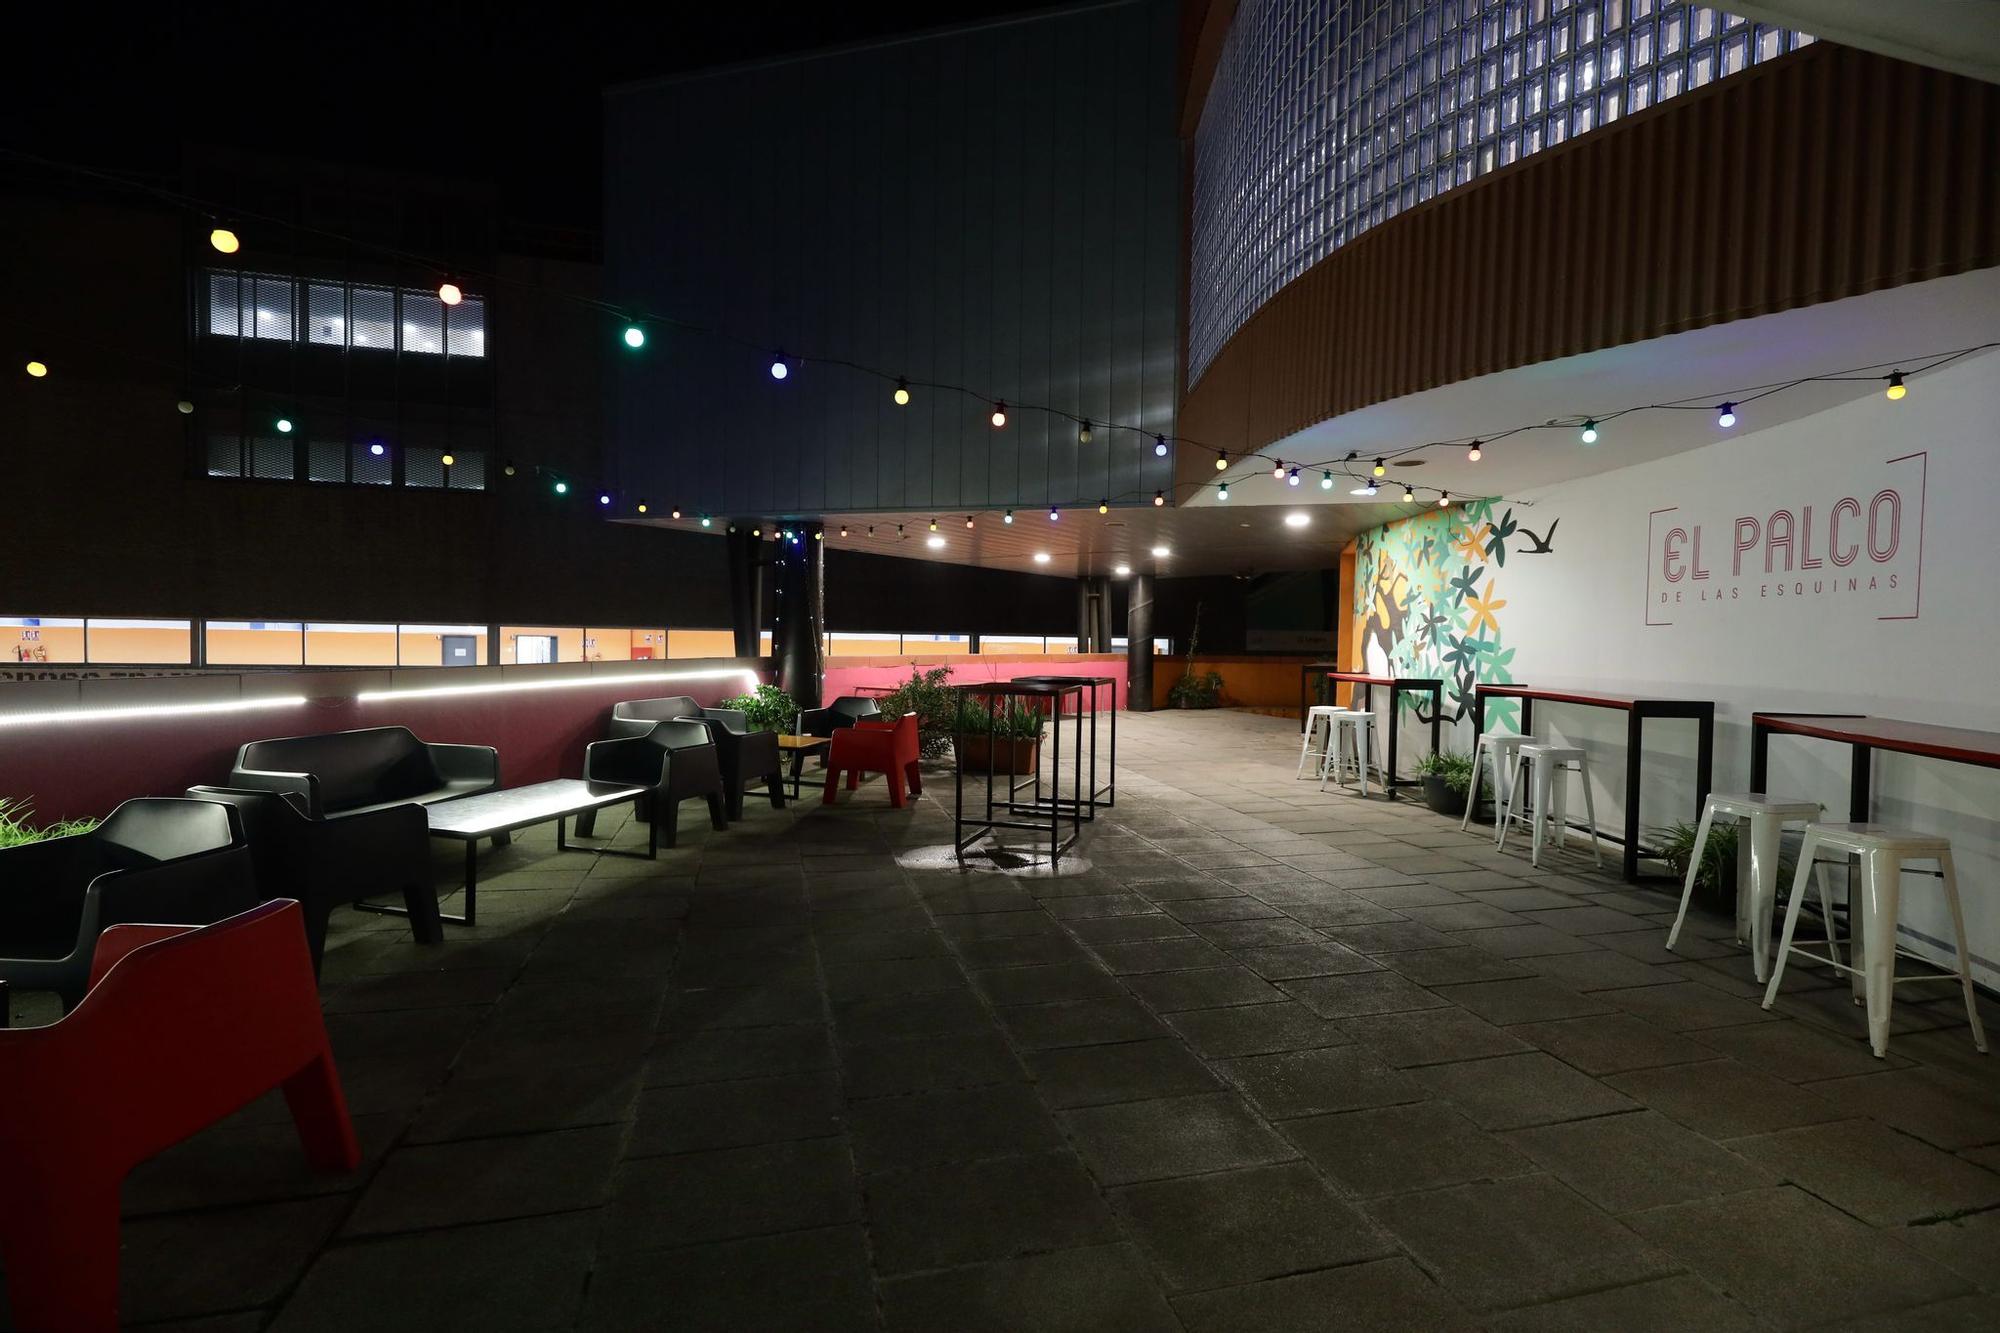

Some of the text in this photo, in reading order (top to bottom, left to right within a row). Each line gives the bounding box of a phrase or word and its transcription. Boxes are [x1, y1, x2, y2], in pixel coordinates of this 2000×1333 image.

[1664, 489, 1901, 583] EL PALCO
[1661, 574, 1898, 604] DE LAS ESQUINAS
